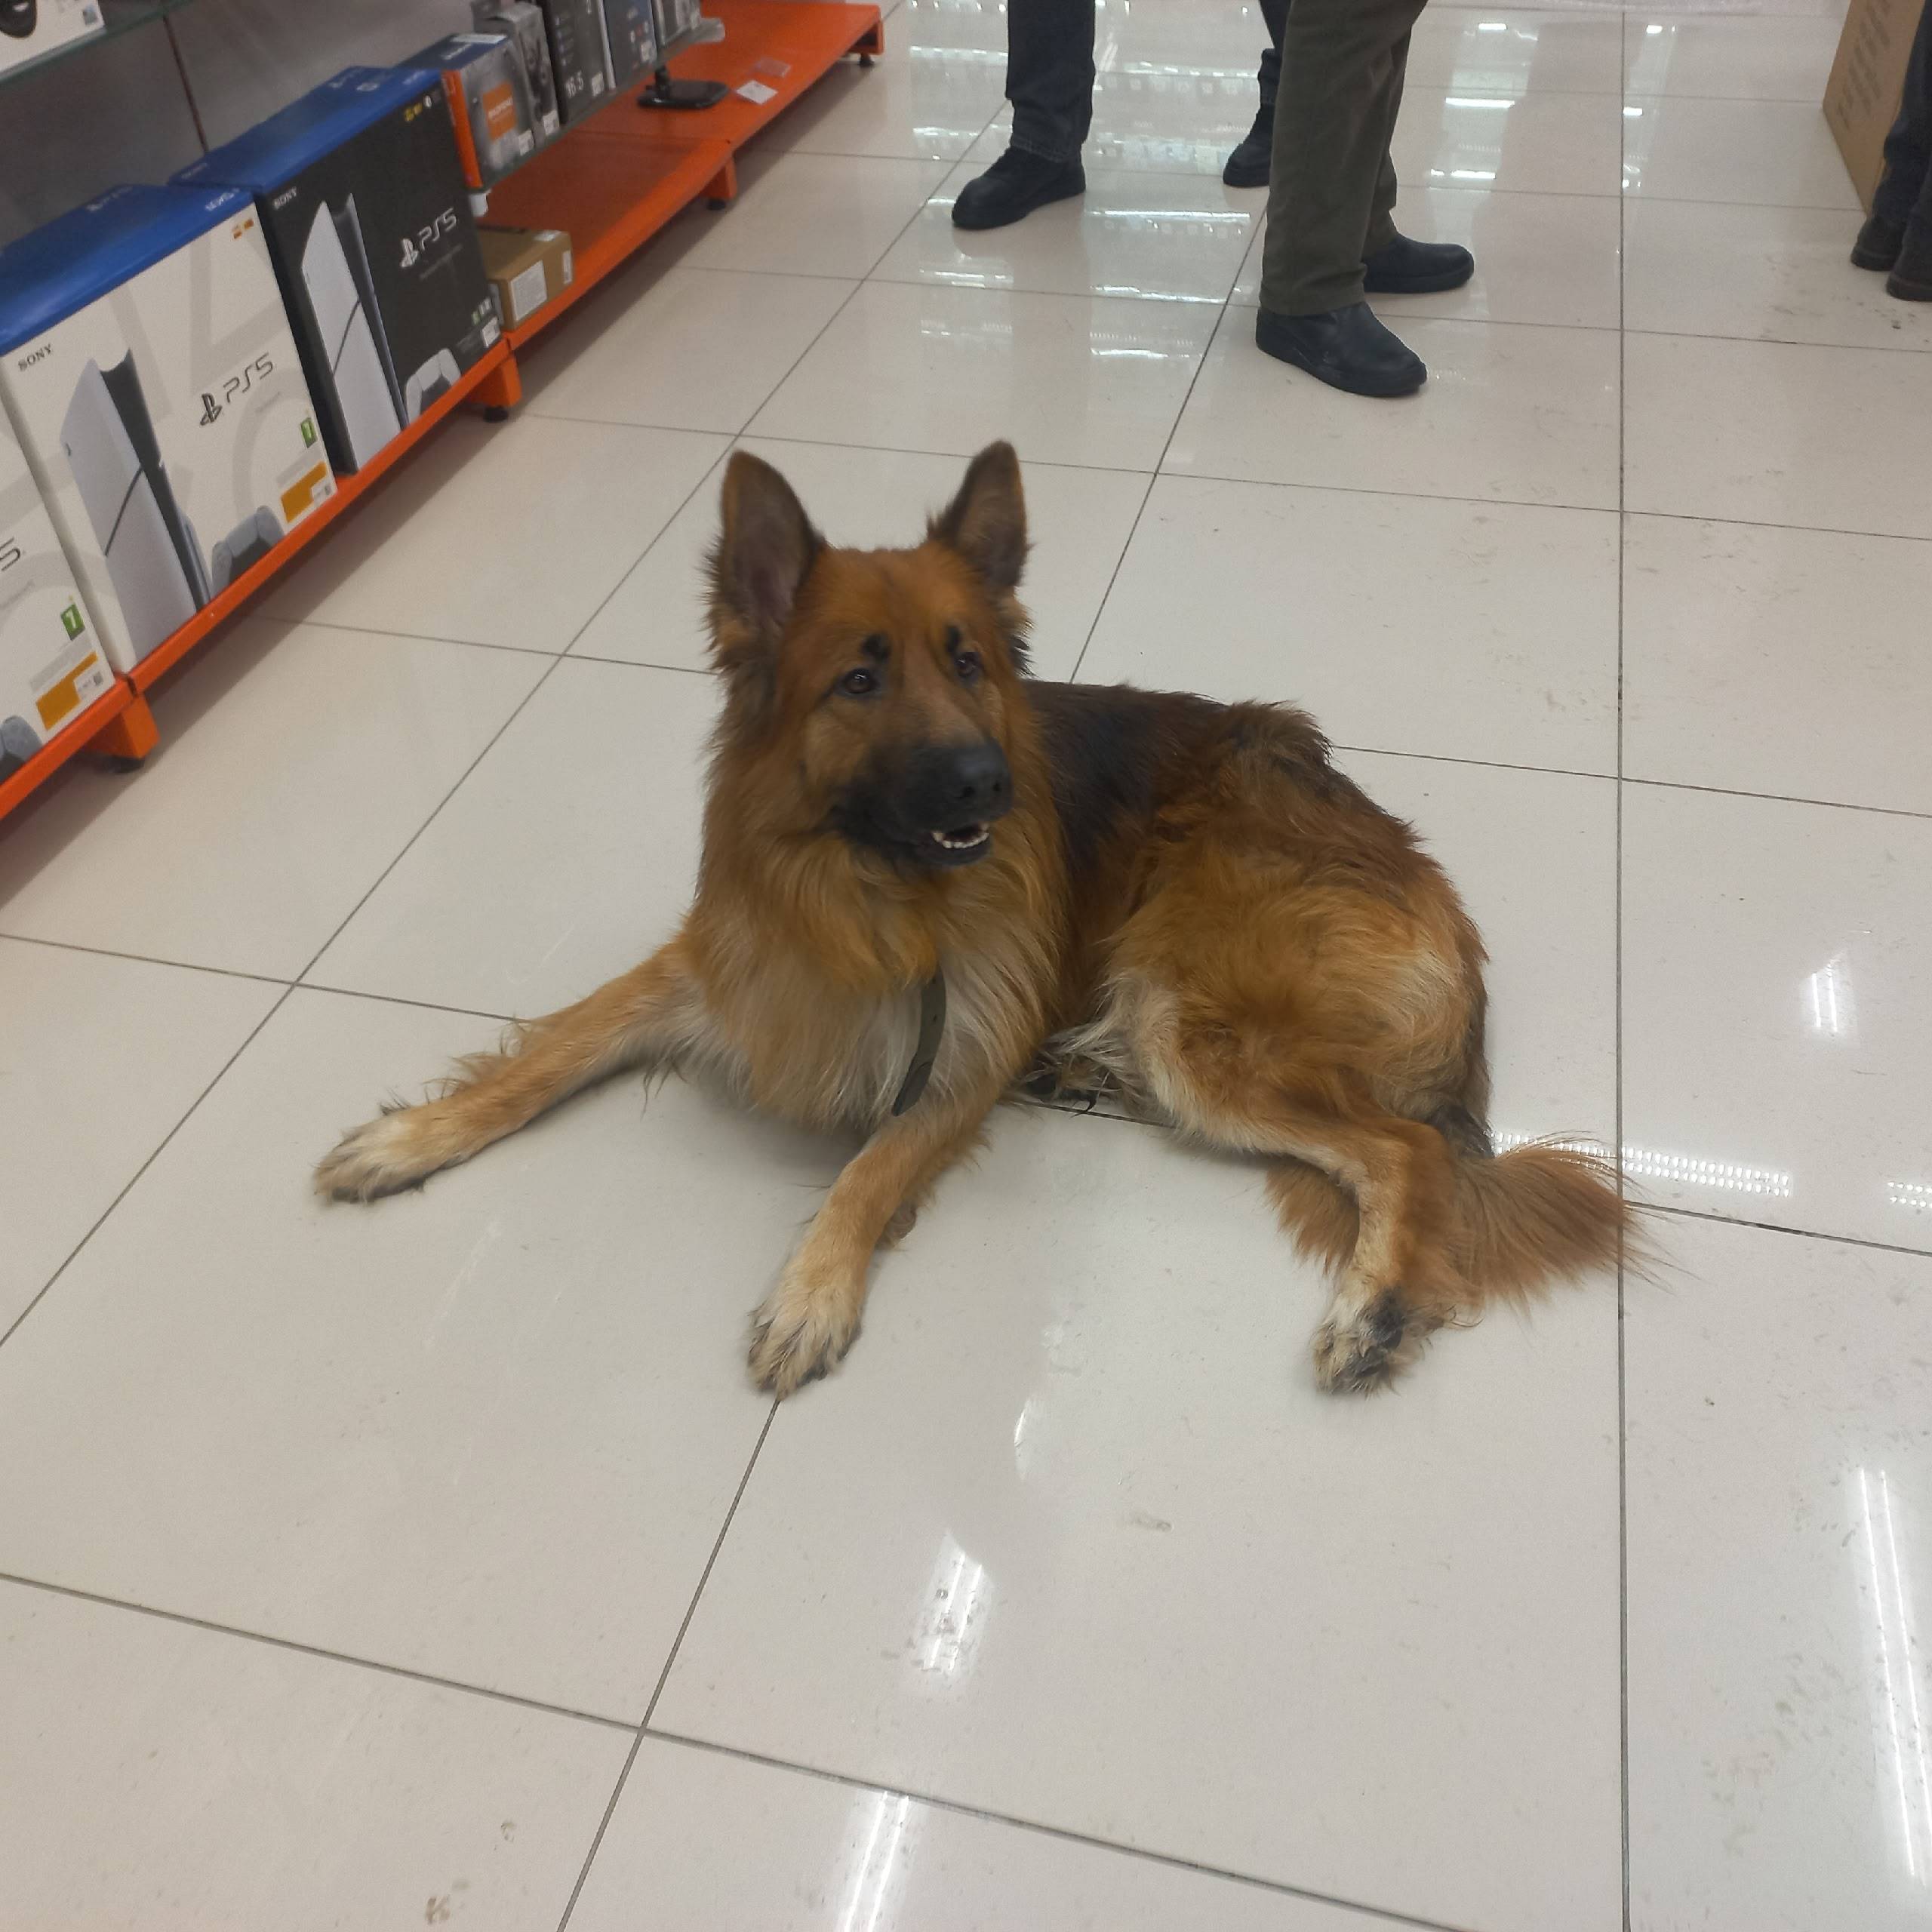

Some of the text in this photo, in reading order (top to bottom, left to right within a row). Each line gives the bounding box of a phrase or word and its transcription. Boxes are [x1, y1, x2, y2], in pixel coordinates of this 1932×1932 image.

[417, 207, 457, 251] PS5
[18, 343, 51, 372] SONY
[223, 352, 273, 403] PS5
